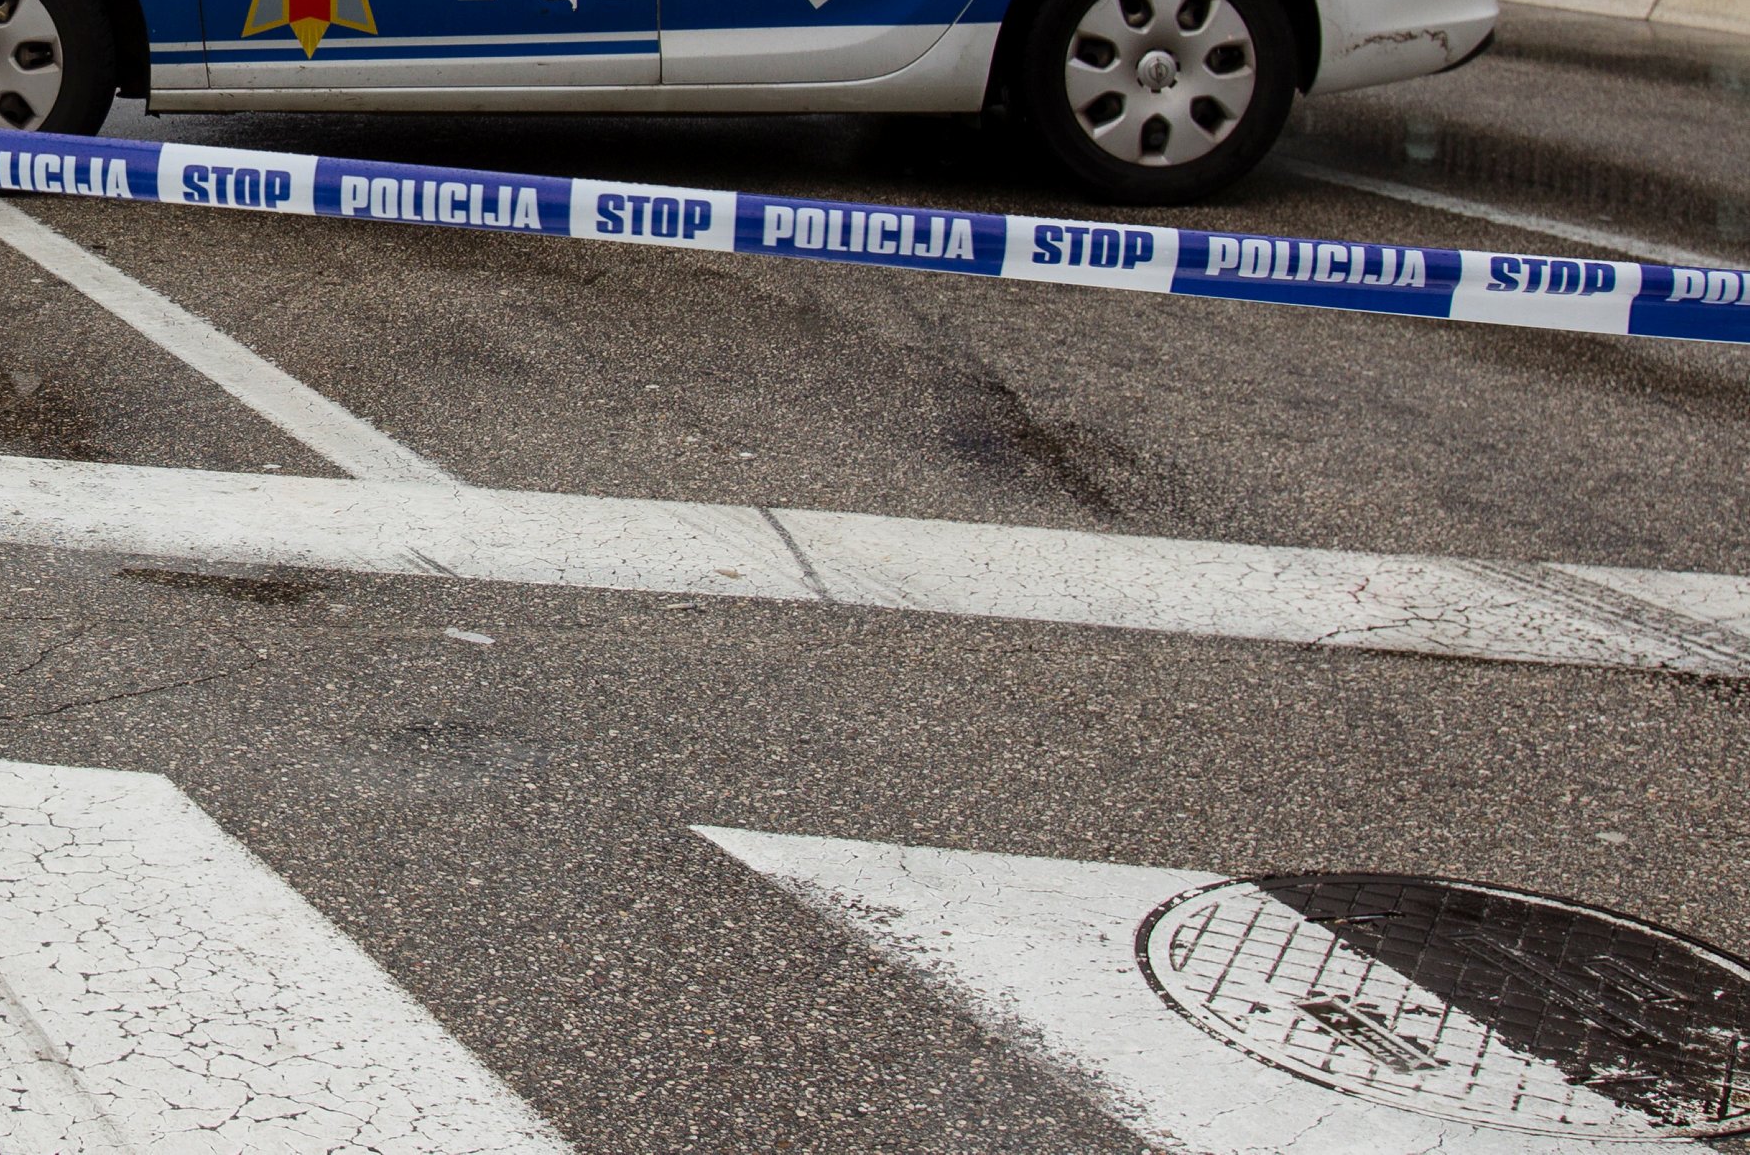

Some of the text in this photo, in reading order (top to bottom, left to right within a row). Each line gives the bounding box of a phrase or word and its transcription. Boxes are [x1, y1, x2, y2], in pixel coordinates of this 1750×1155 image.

[182, 164, 291, 208] STOP
[340, 175, 542, 230] POLICIJA
[595, 193, 712, 240] STOP
[762, 204, 975, 260] POLICIJA
[1031, 224, 1154, 270] STOP
[1205, 236, 1426, 288] POLICIJA
[1486, 256, 1617, 297] STOP
